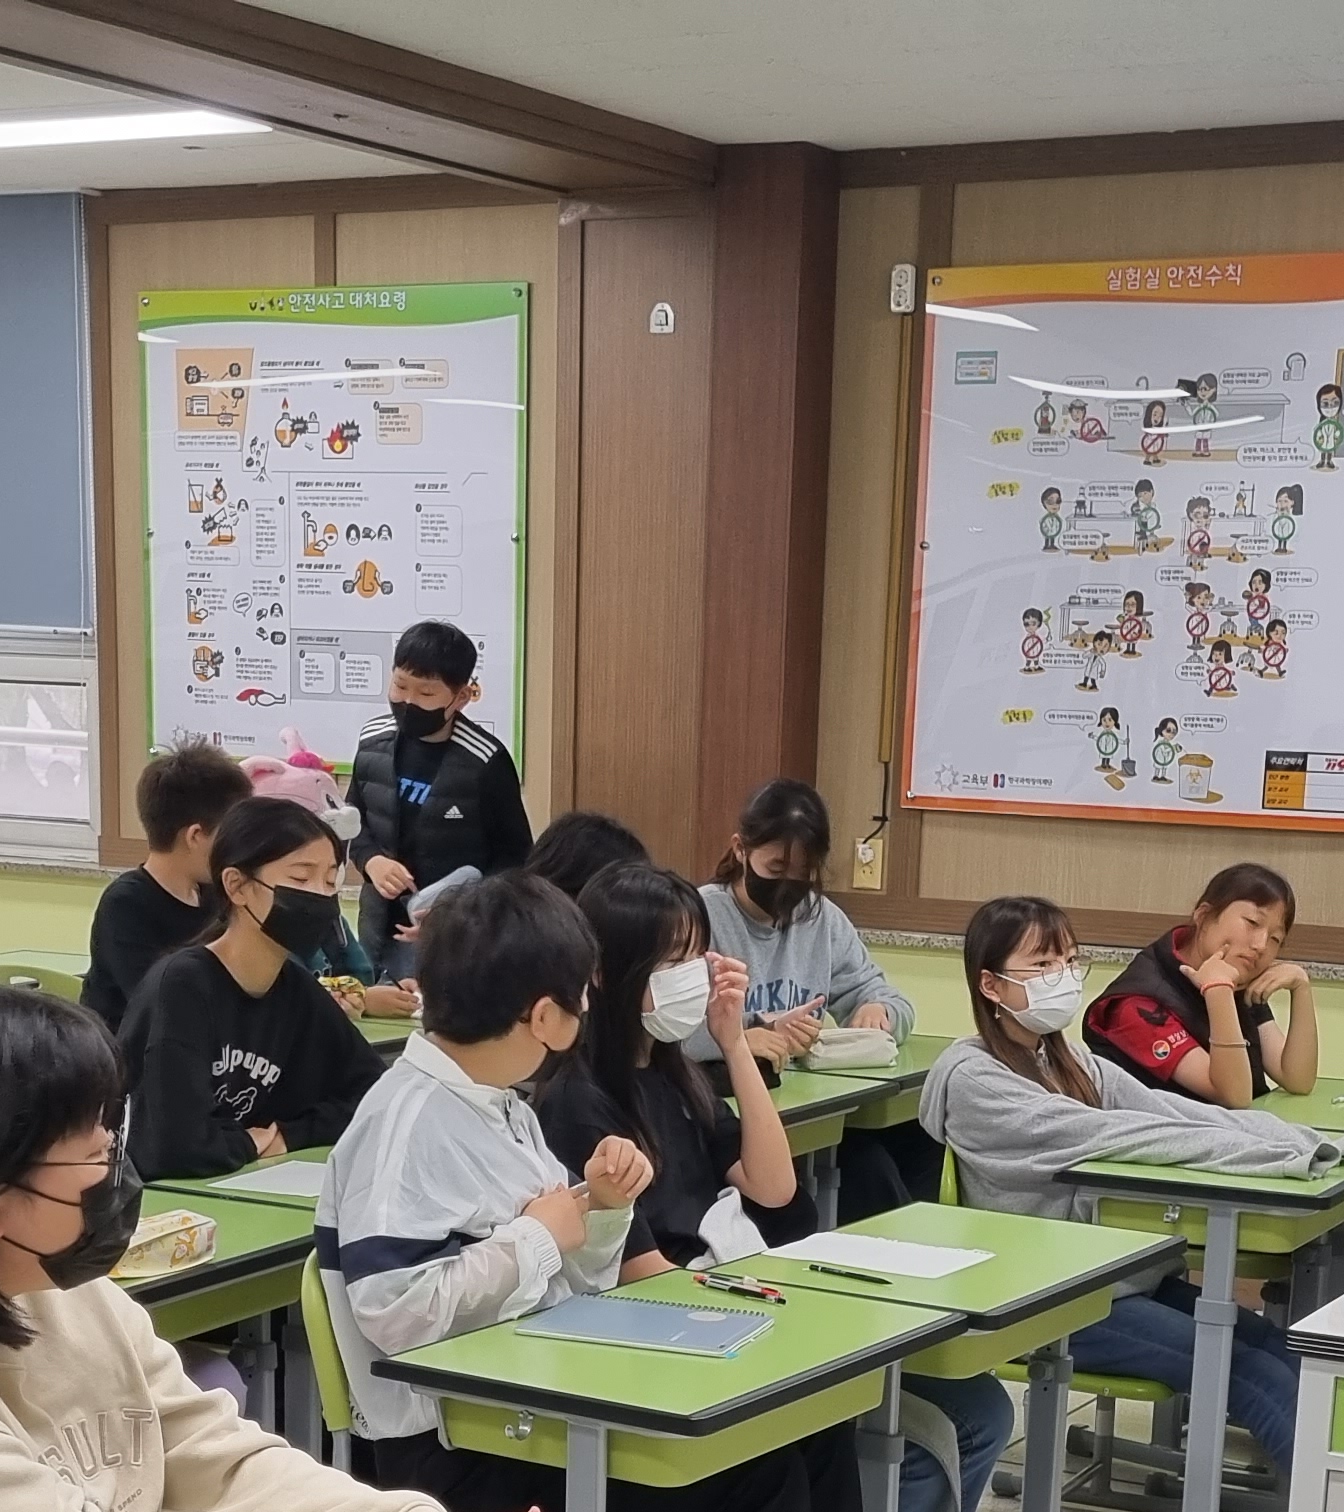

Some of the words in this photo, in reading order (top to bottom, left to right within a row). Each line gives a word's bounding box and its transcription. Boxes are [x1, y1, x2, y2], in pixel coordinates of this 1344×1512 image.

[1107, 266, 1160, 291] 실험실
[1166, 262, 1242, 288] 안전수칙
[288, 292, 346, 313] 안전사고
[349, 290, 407, 312] 대처요령
[962, 773, 989, 786] 교육부
